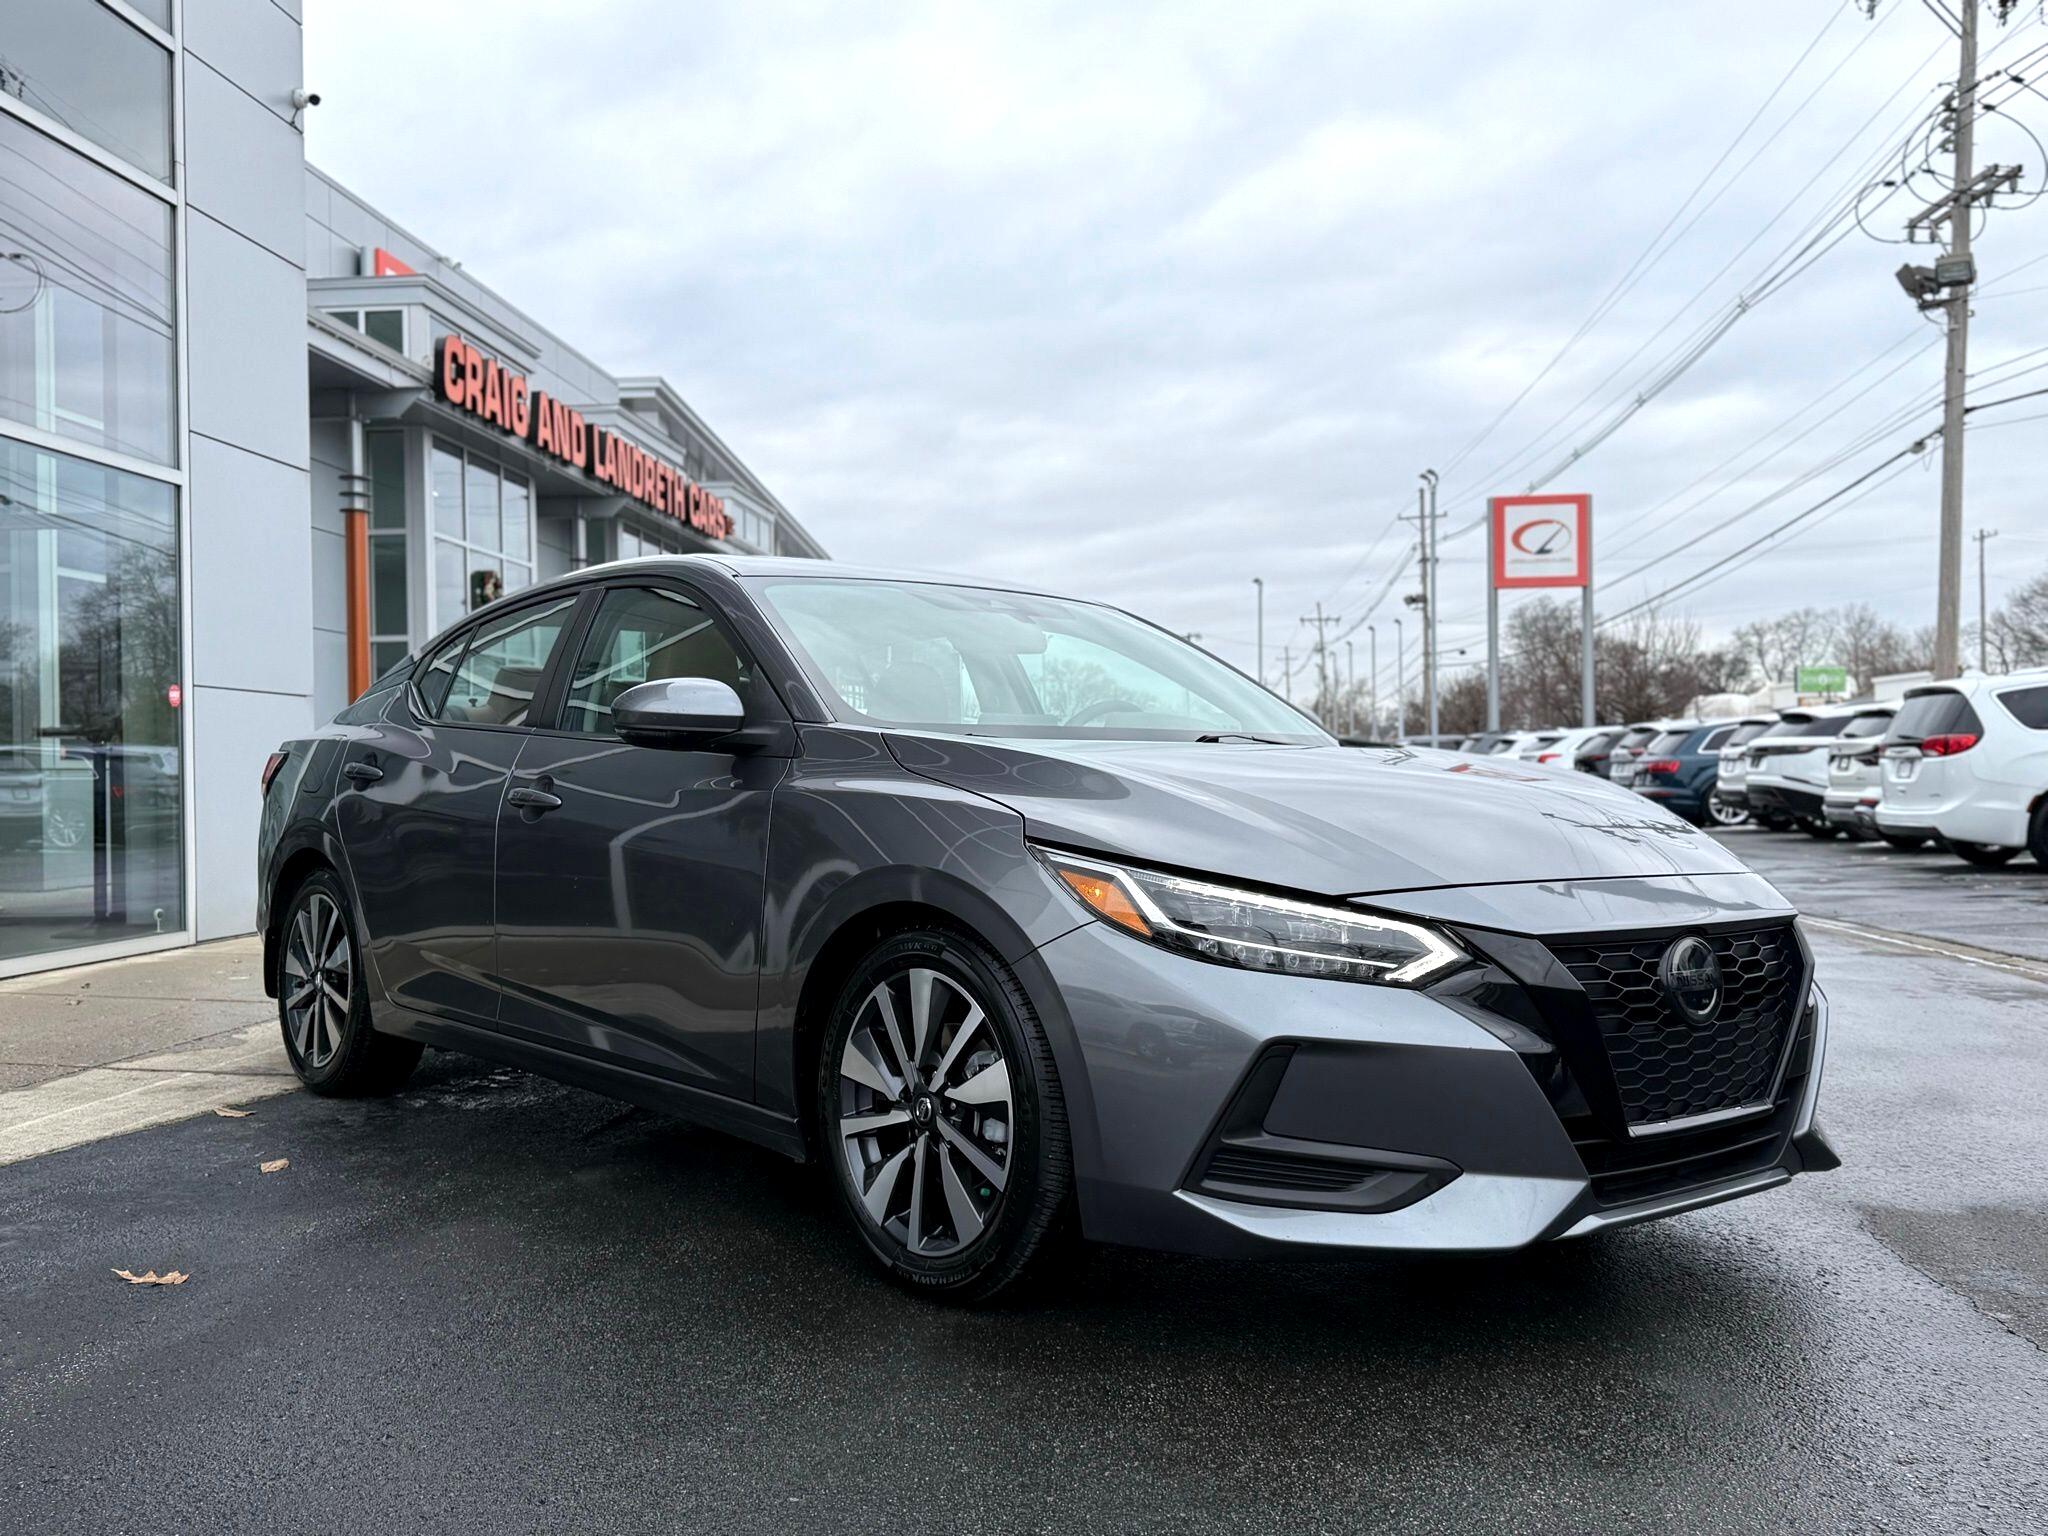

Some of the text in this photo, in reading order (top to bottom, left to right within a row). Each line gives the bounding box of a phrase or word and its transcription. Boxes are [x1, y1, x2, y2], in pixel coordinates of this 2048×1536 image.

[444, 334, 726, 541] CRAIG AND LANDRETH CARS
